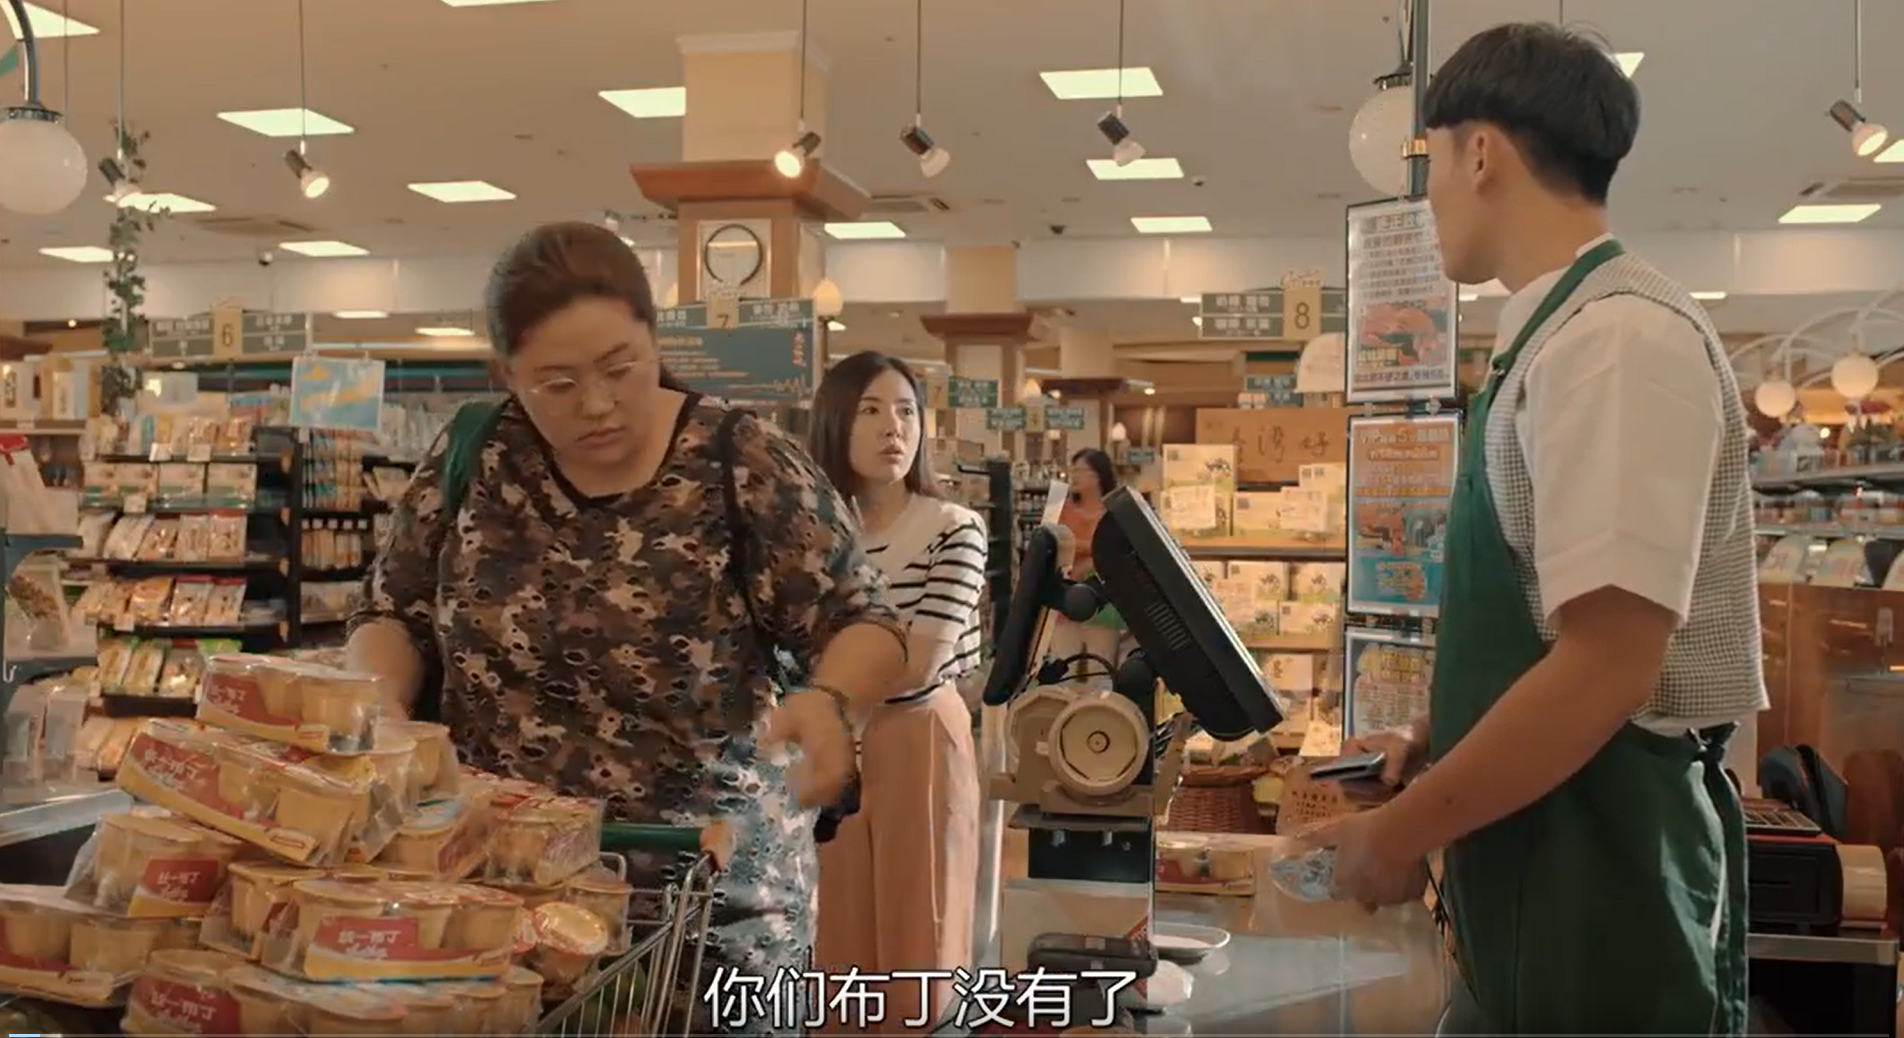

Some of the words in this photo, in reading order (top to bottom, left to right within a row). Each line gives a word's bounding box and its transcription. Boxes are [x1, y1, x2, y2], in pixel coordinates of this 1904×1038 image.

[716, 313, 729, 328] 7
[1294, 301, 1310, 330] 8
[221, 323, 234, 347] 6
